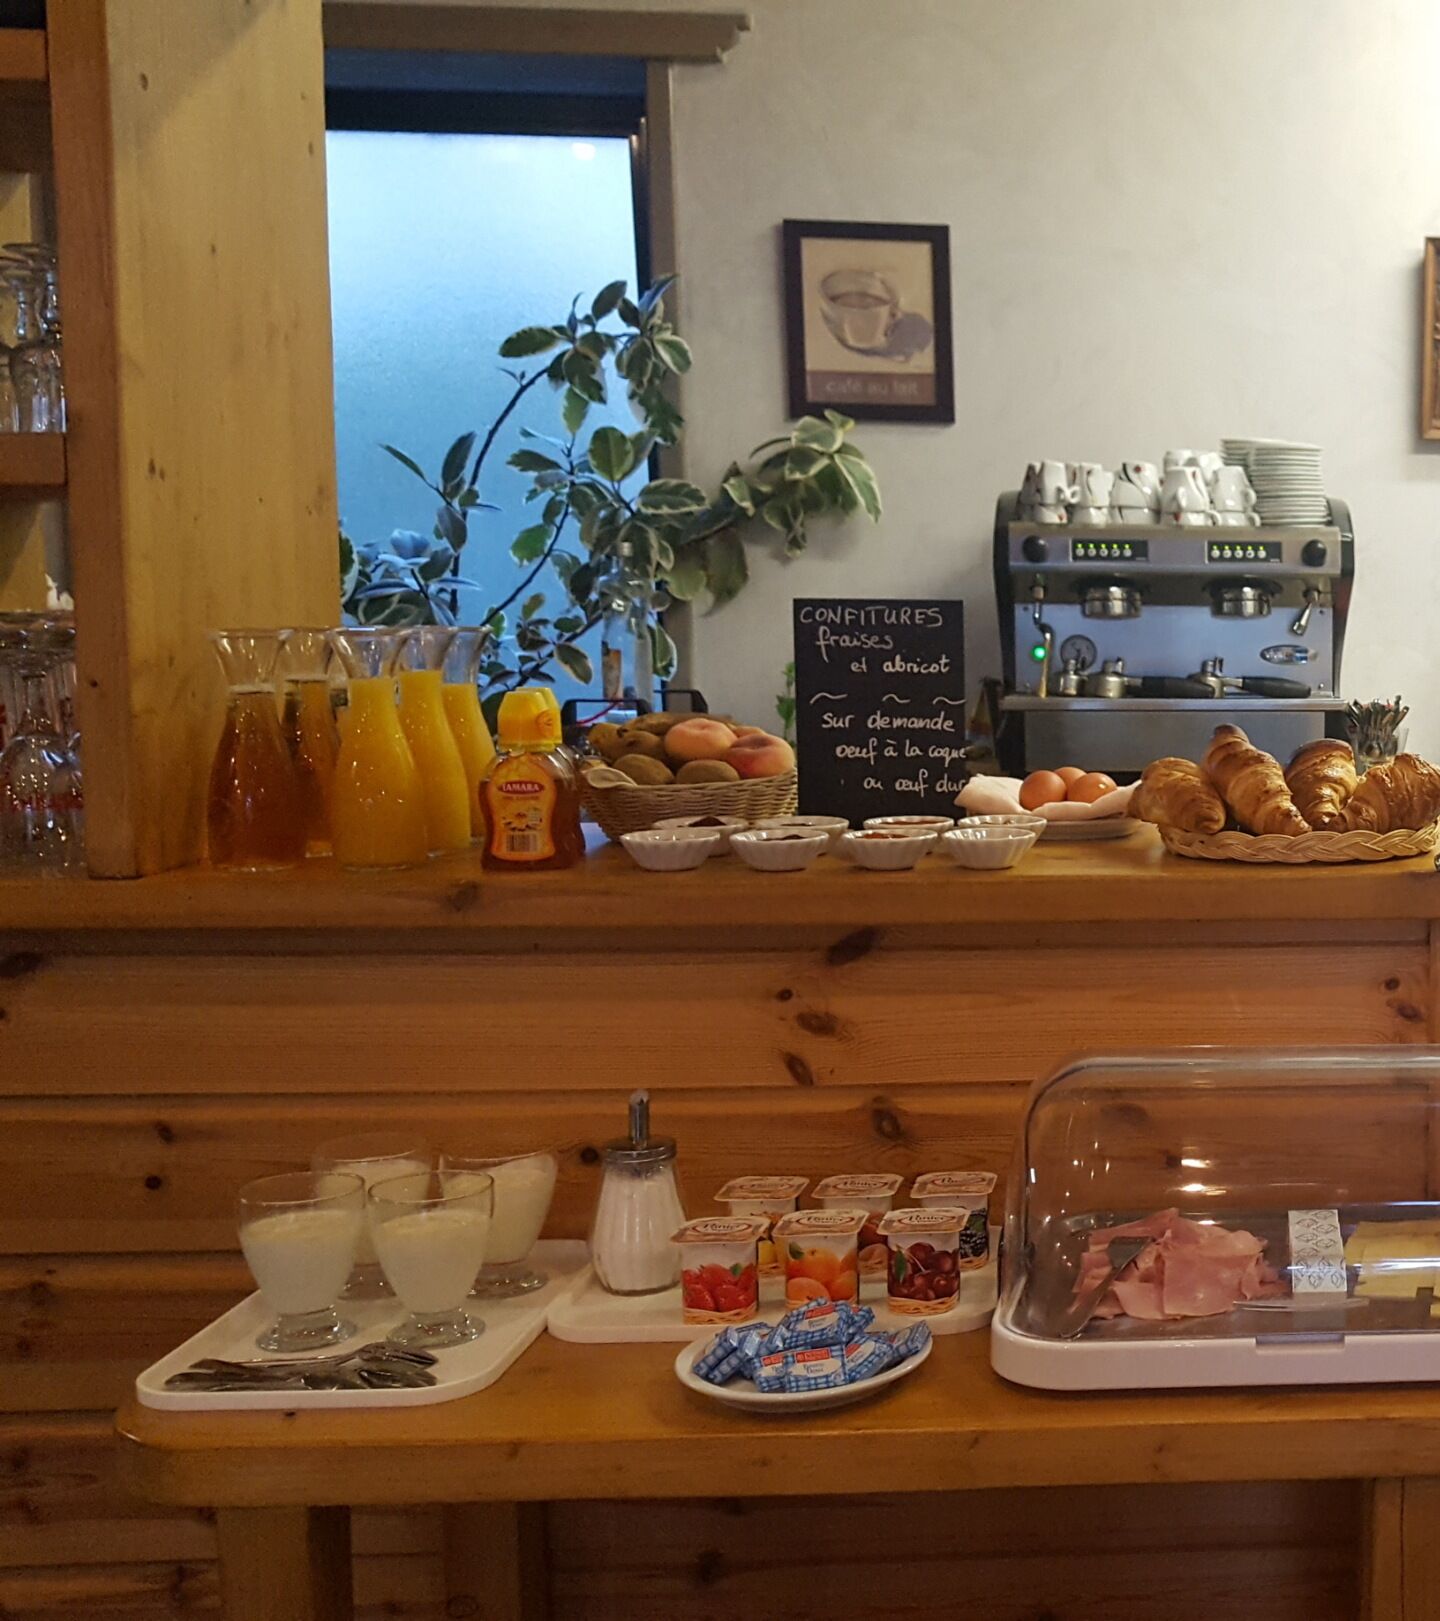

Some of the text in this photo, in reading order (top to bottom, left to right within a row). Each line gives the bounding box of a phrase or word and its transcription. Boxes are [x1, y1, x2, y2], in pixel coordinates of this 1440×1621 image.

[800, 605, 943, 628] CONFITURES
[816, 625, 894, 663] fraises
[850, 654, 951, 674] et abricot
[866, 710, 955, 732] demande
[883, 739, 899, 757] à
[904, 739, 923, 756] la
[928, 744, 968, 768] coque
[863, 776, 884, 790] ou
